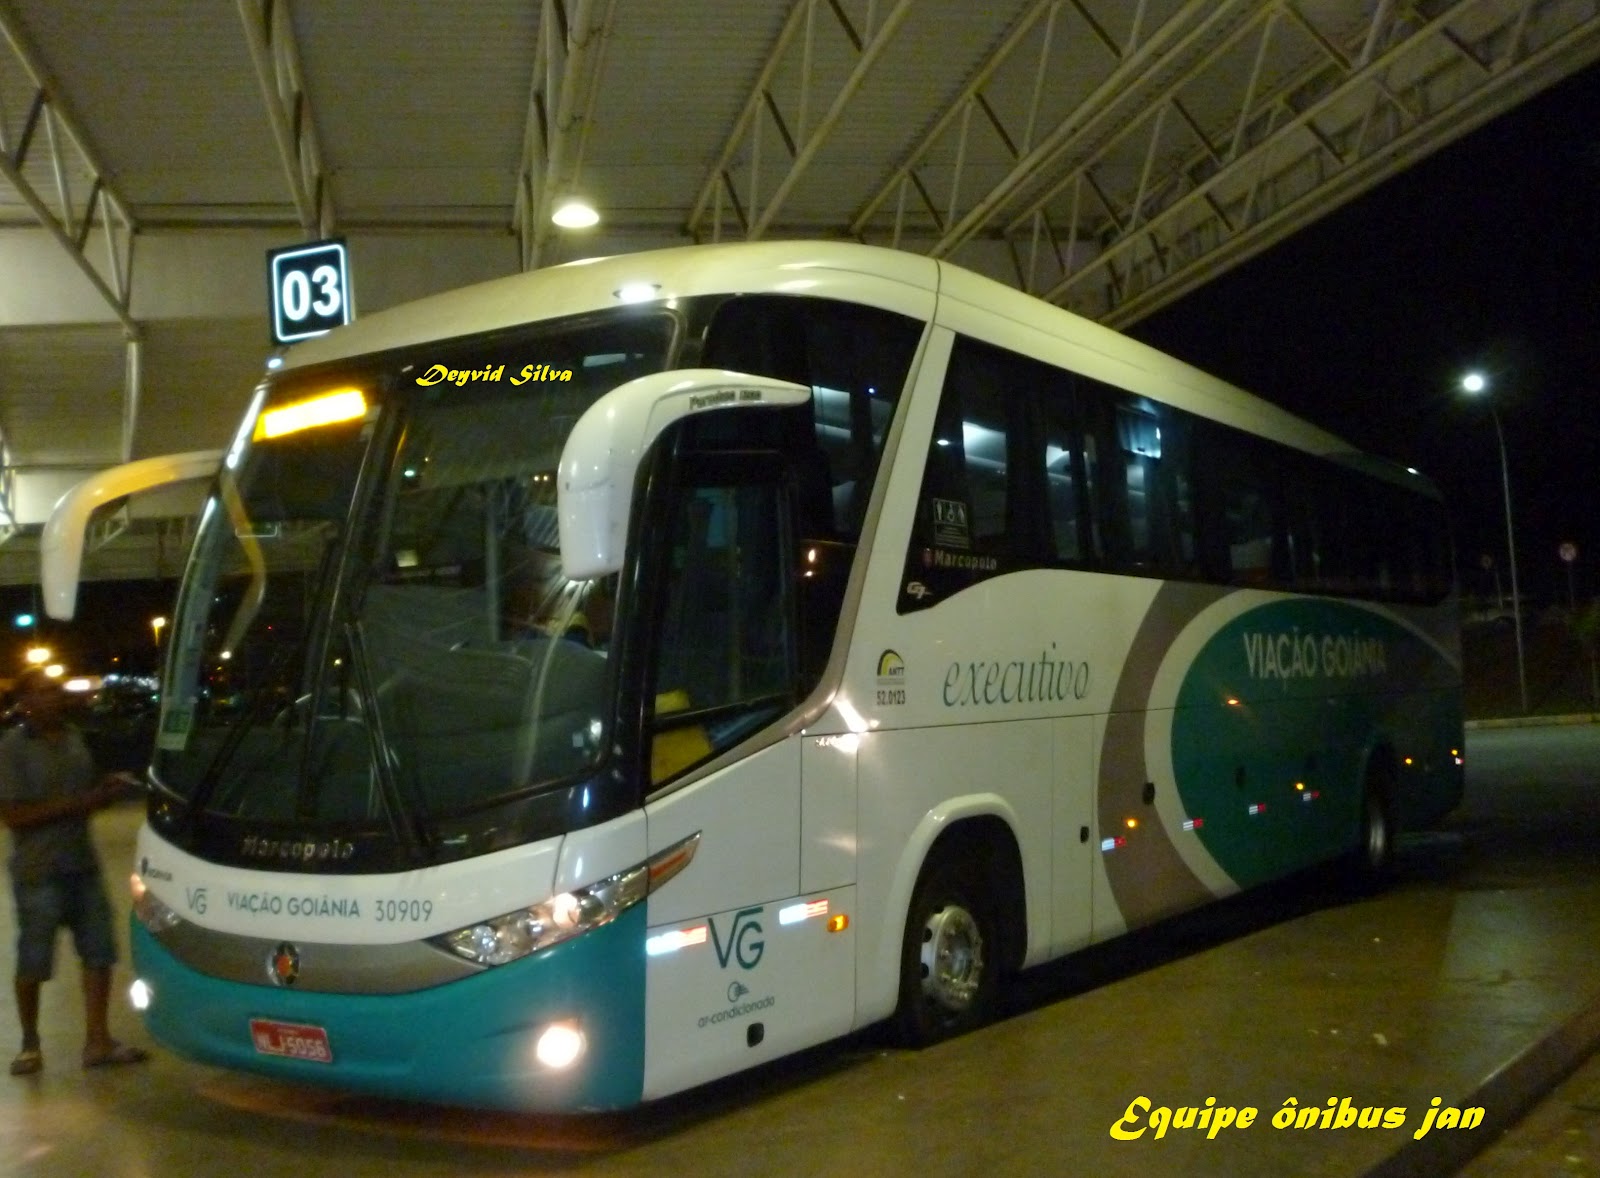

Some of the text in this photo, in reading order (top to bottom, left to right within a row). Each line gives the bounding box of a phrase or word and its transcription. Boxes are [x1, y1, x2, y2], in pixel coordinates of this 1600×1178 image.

[282, 265, 341, 321] 03
[942, 640, 1090, 707] executivo
[227, 893, 433, 922] VIAÇÃO GOIÂNIA 30909
[707, 906, 765, 970] VG
[697, 994, 775, 1029] ar-condicionado
